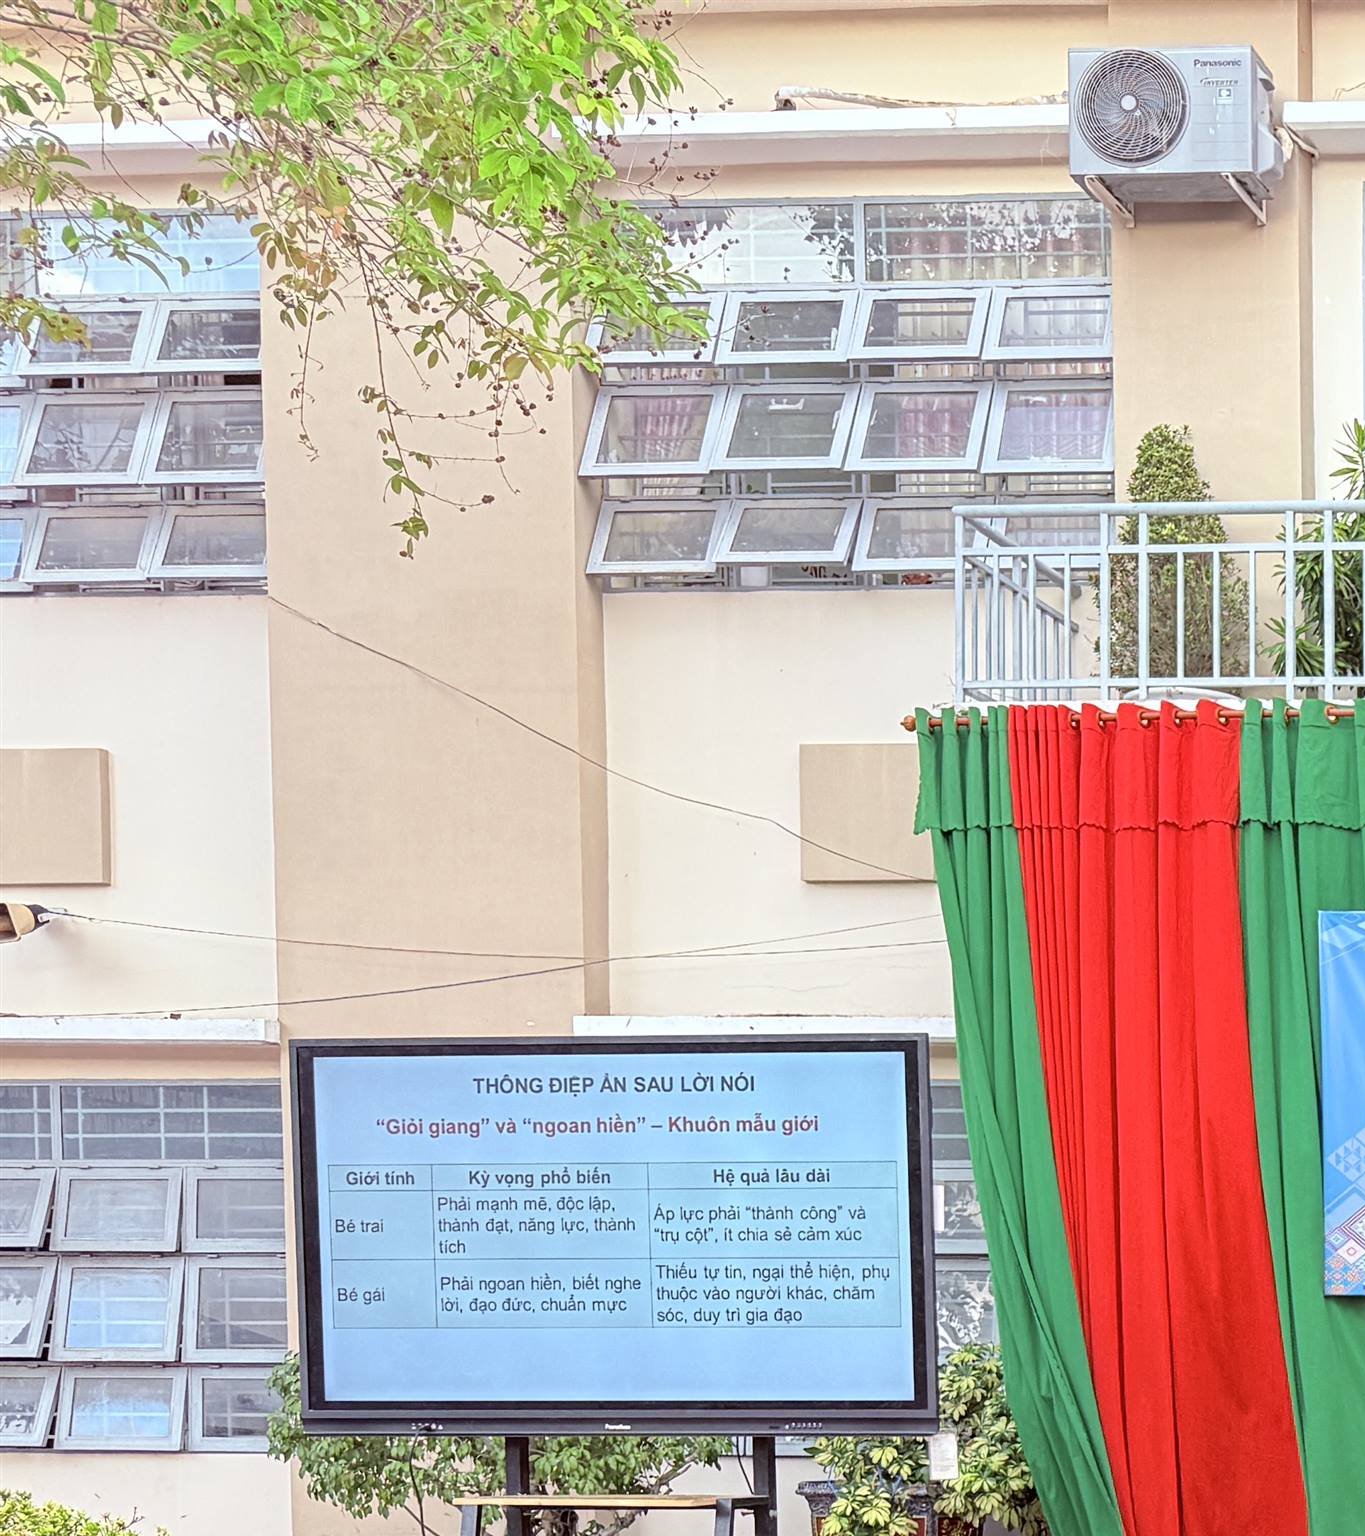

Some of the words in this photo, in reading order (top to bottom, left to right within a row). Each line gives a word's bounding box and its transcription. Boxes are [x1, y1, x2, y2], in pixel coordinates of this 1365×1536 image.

[1193, 59, 1242, 68] Panasonic
[472, 1073, 544, 1095] THÔNG
[548, 1076, 594, 1098] ĐIỆP
[633, 1076, 674, 1093] SAU
[680, 1071, 714, 1093] LỜI
[720, 1071, 755, 1092] NÓI
[428, 1117, 490, 1139] giang”
[495, 1117, 517, 1134] và
[522, 1117, 592, 1138] “ngoan
[668, 1115, 730, 1133] Khuôn
[736, 1112, 776, 1133] mẫu
[781, 1114, 819, 1136] giới
[345, 1171, 380, 1186] Giới
[384, 1170, 415, 1186] tính
[468, 1170, 491, 1189] Kỳ
[494, 1173, 534, 1188] vọng
[540, 1166, 571, 1188] phổ
[576, 1166, 611, 1184] biến
[713, 1168, 735, 1187] Hệ
[740, 1168, 770, 1187] quả
[775, 1168, 800, 1183] lâu
[805, 1168, 830, 1183] dài
[437, 1195, 471, 1212] Phải
[476, 1196, 518, 1214] mạnh
[523, 1196, 552, 1212] mẽ,
[556, 1195, 584, 1214] độc
[588, 1195, 616, 1214] lập,
[653, 1202, 675, 1225] Áp
[679, 1206, 704, 1224] lực
[708, 1205, 741, 1224] phải
[847, 1205, 867, 1220] và
[335, 1218, 356, 1233] Bé
[360, 1218, 384, 1233] trai
[438, 1217, 480, 1233] thành
[485, 1217, 513, 1235] đạt,
[518, 1217, 555, 1236] năng
[560, 1217, 589, 1235] lực,
[593, 1217, 636, 1232] thành
[724, 1227, 734, 1242] ít
[737, 1227, 769, 1242] chia
[774, 1225, 792, 1242] sẻ
[797, 1225, 831, 1242] cảm
[835, 1226, 862, 1241] xúc
[438, 1239, 466, 1254] tích
